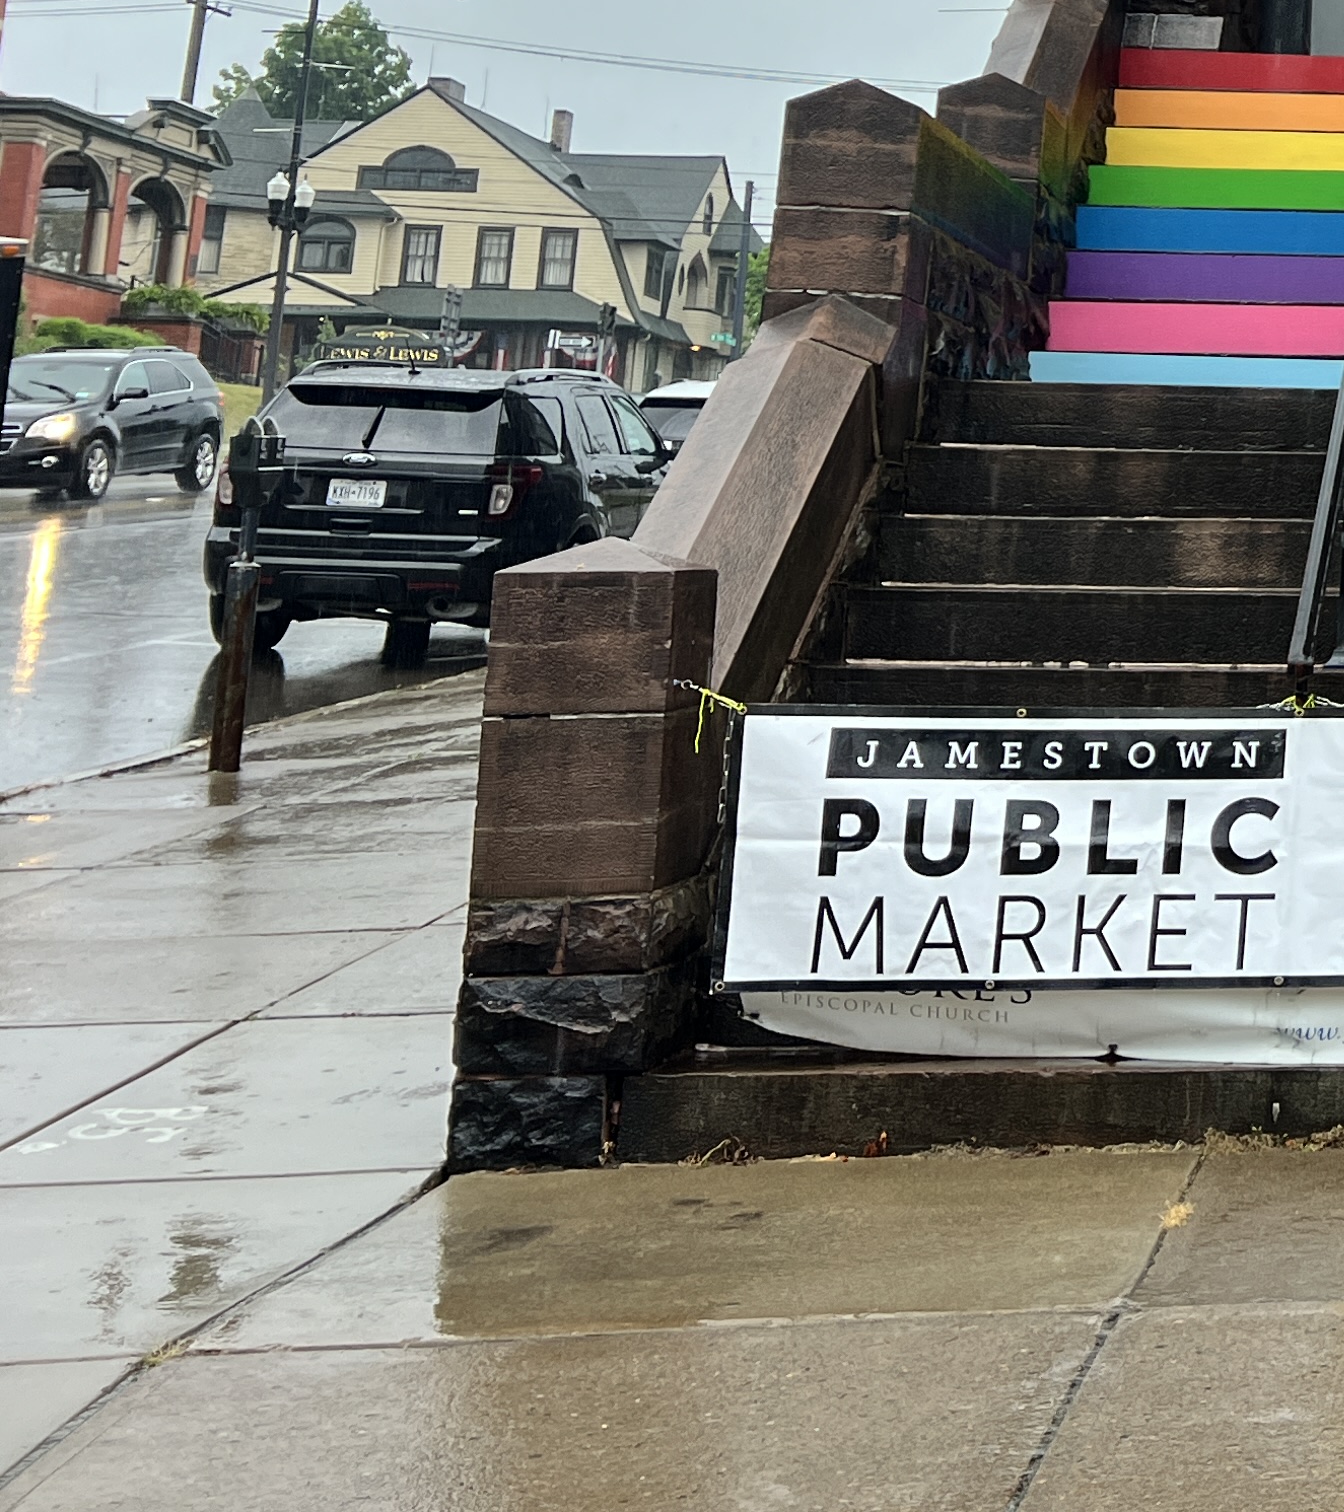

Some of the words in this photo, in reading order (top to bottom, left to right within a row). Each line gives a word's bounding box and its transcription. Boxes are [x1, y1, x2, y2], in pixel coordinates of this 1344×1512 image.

[372, 345, 387, 359] &
[388, 346, 439, 362] LEWIS
[856, 739, 1261, 770] JAMESTOWN
[816, 796, 1281, 878] PUBLIC
[809, 892, 1276, 975] MARKET
[779, 990, 898, 1016] EPISCOPAL
[909, 1003, 1009, 1023] CHURCH
